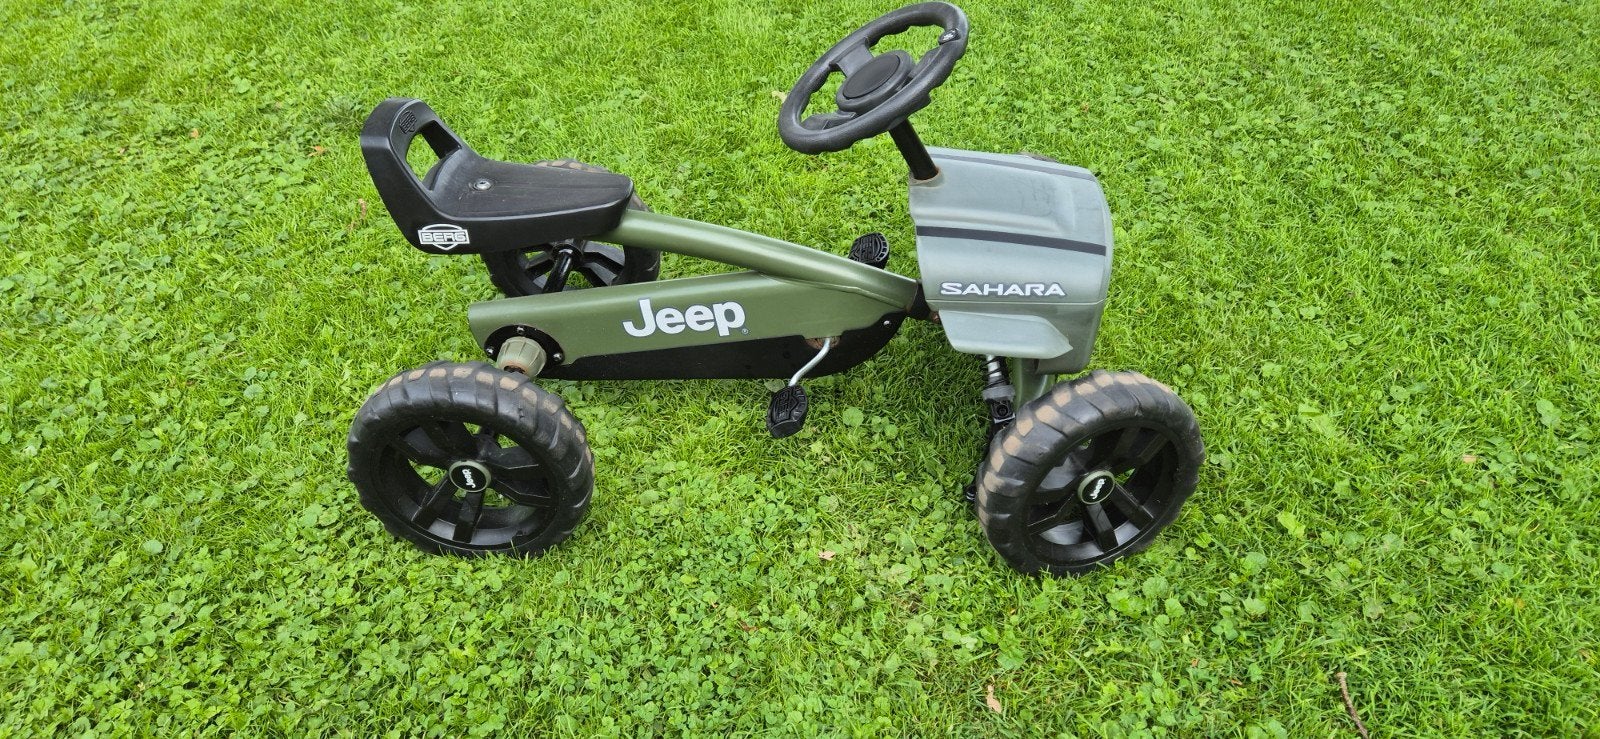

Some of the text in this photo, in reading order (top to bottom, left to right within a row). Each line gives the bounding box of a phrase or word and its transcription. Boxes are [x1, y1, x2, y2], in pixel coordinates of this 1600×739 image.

[421, 232, 466, 242] BERG
[940, 282, 1066, 296] SAHARA
[622, 298, 746, 338] Jeep
[462, 469, 476, 488] Jeep
